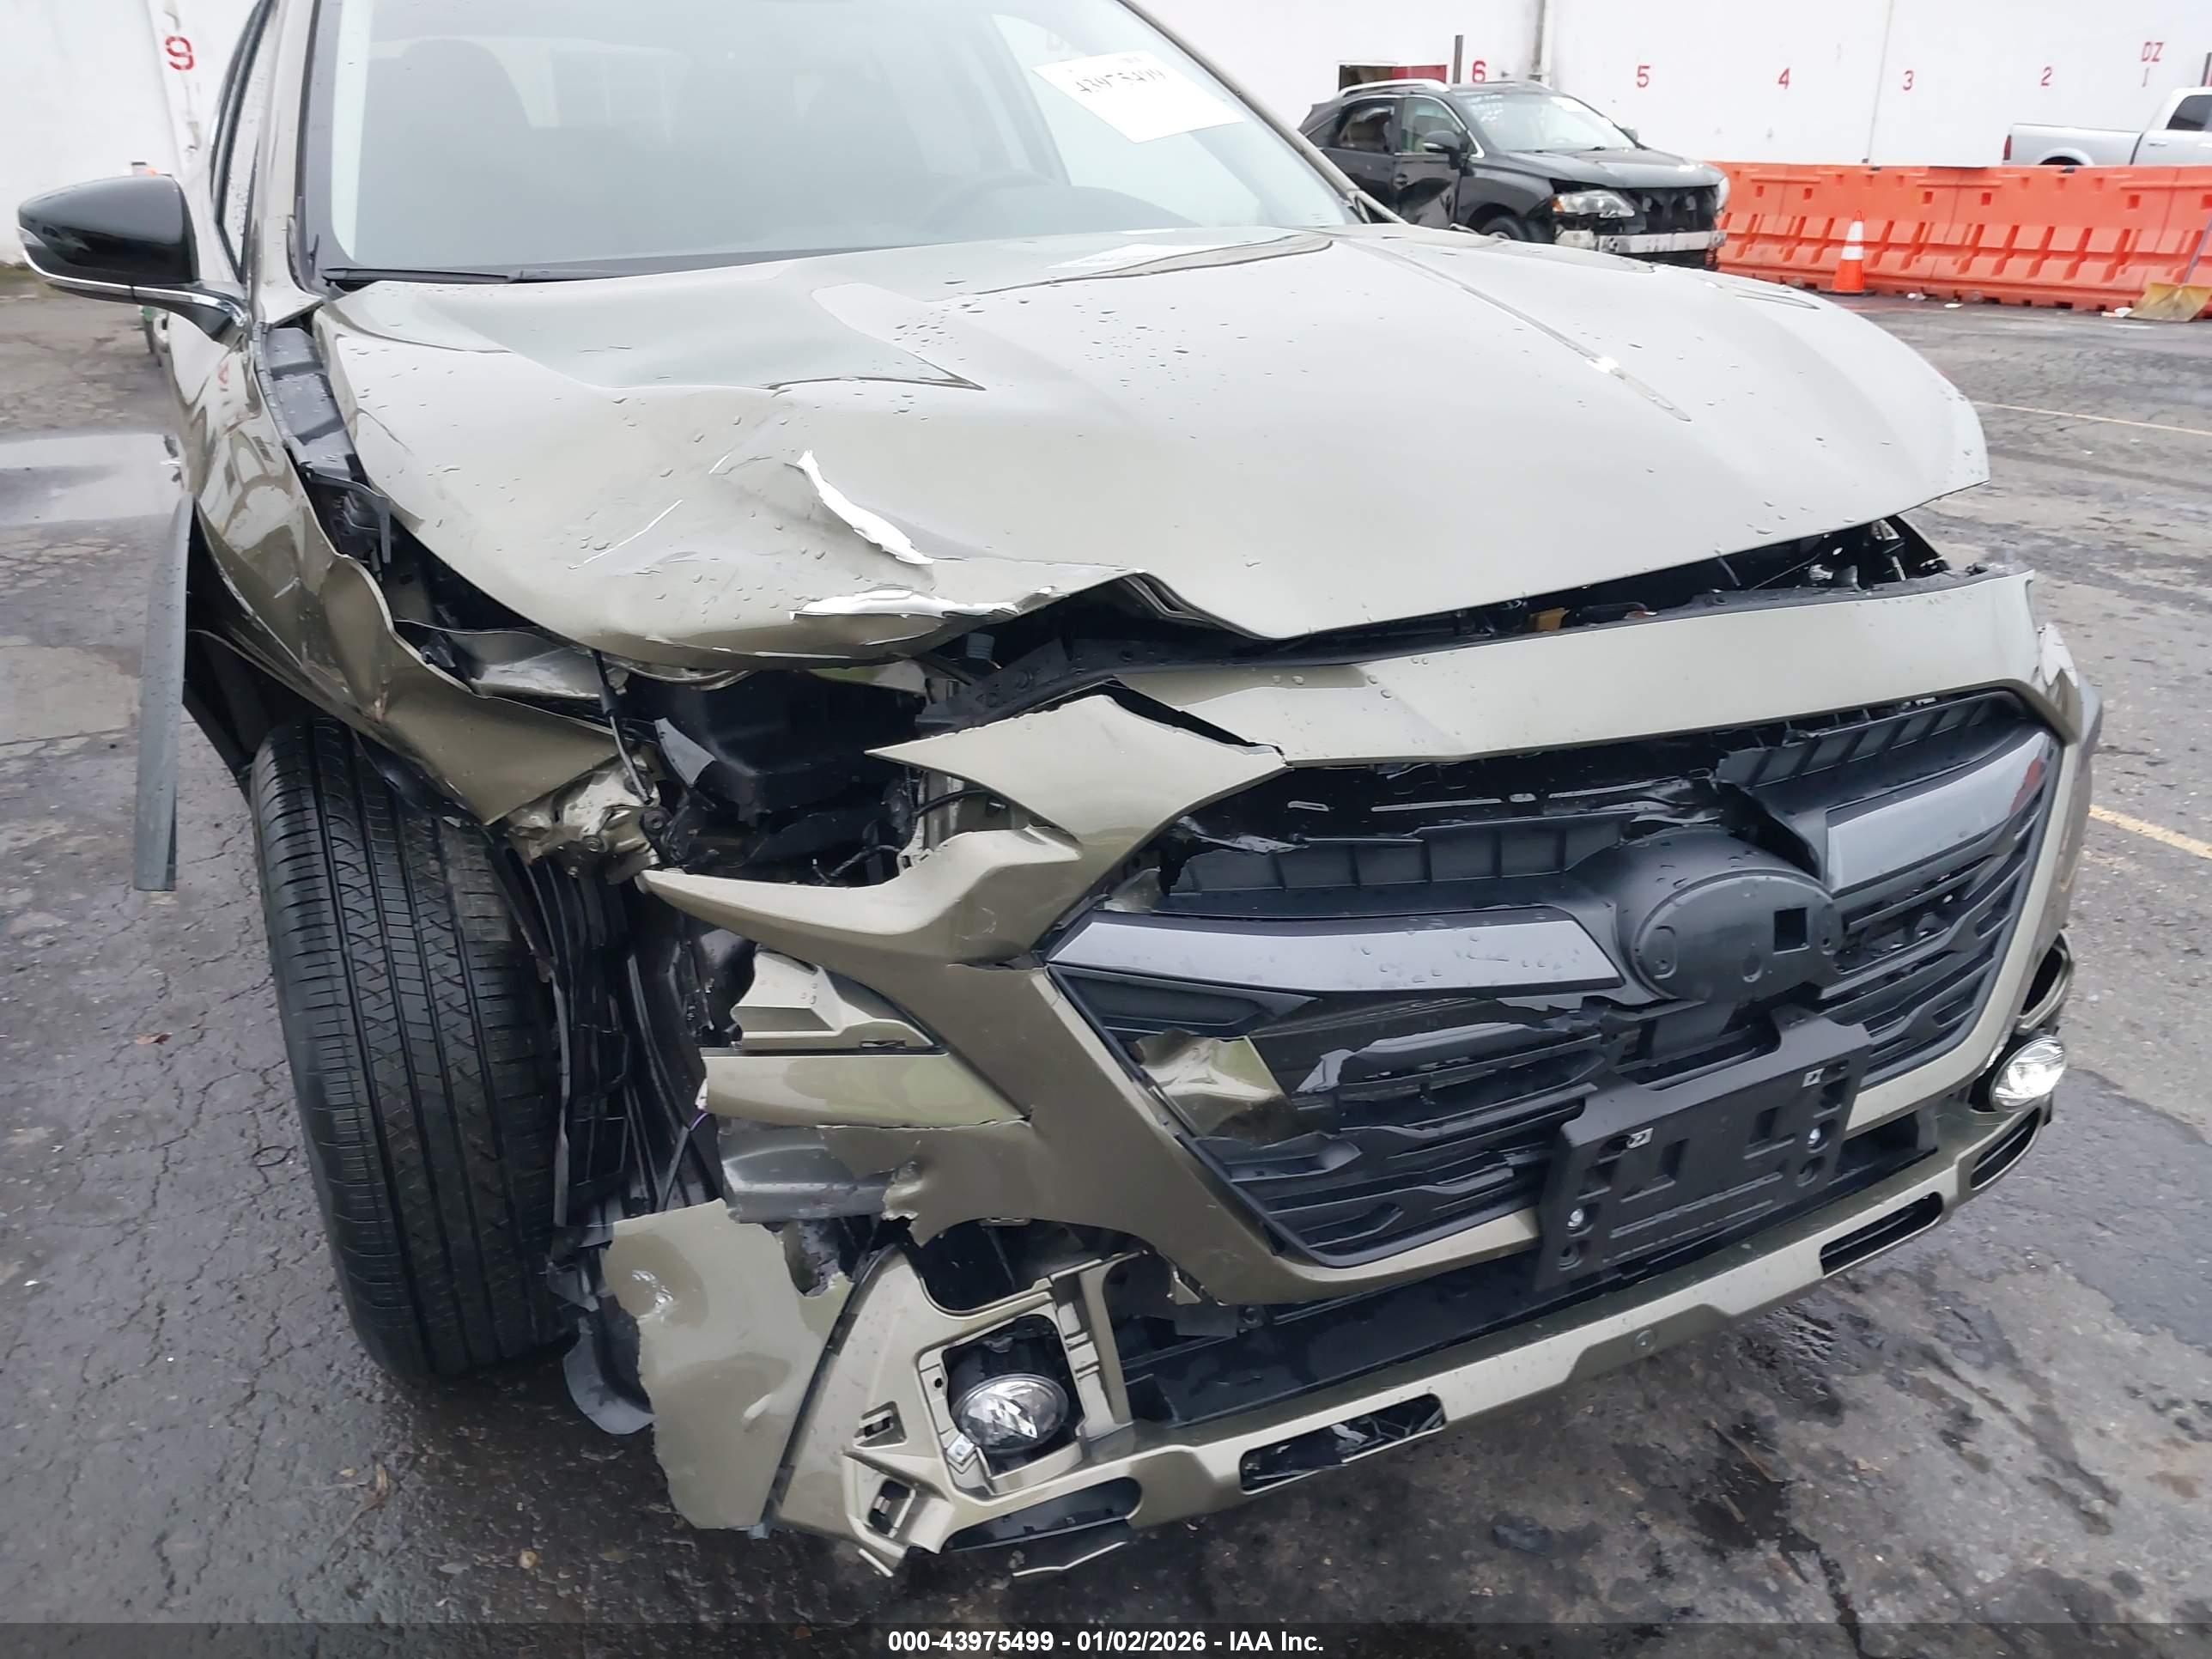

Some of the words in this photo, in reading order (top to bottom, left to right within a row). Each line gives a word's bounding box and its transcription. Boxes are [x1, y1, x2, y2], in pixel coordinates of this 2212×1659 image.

[165, 36, 195, 70] 9
[1472, 60, 1486, 83] 6
[1636, 64, 1651, 88] 5
[1778, 68, 1790, 89] 4
[1902, 70, 1915, 92] 3
[2040, 66, 2053, 88] 2
